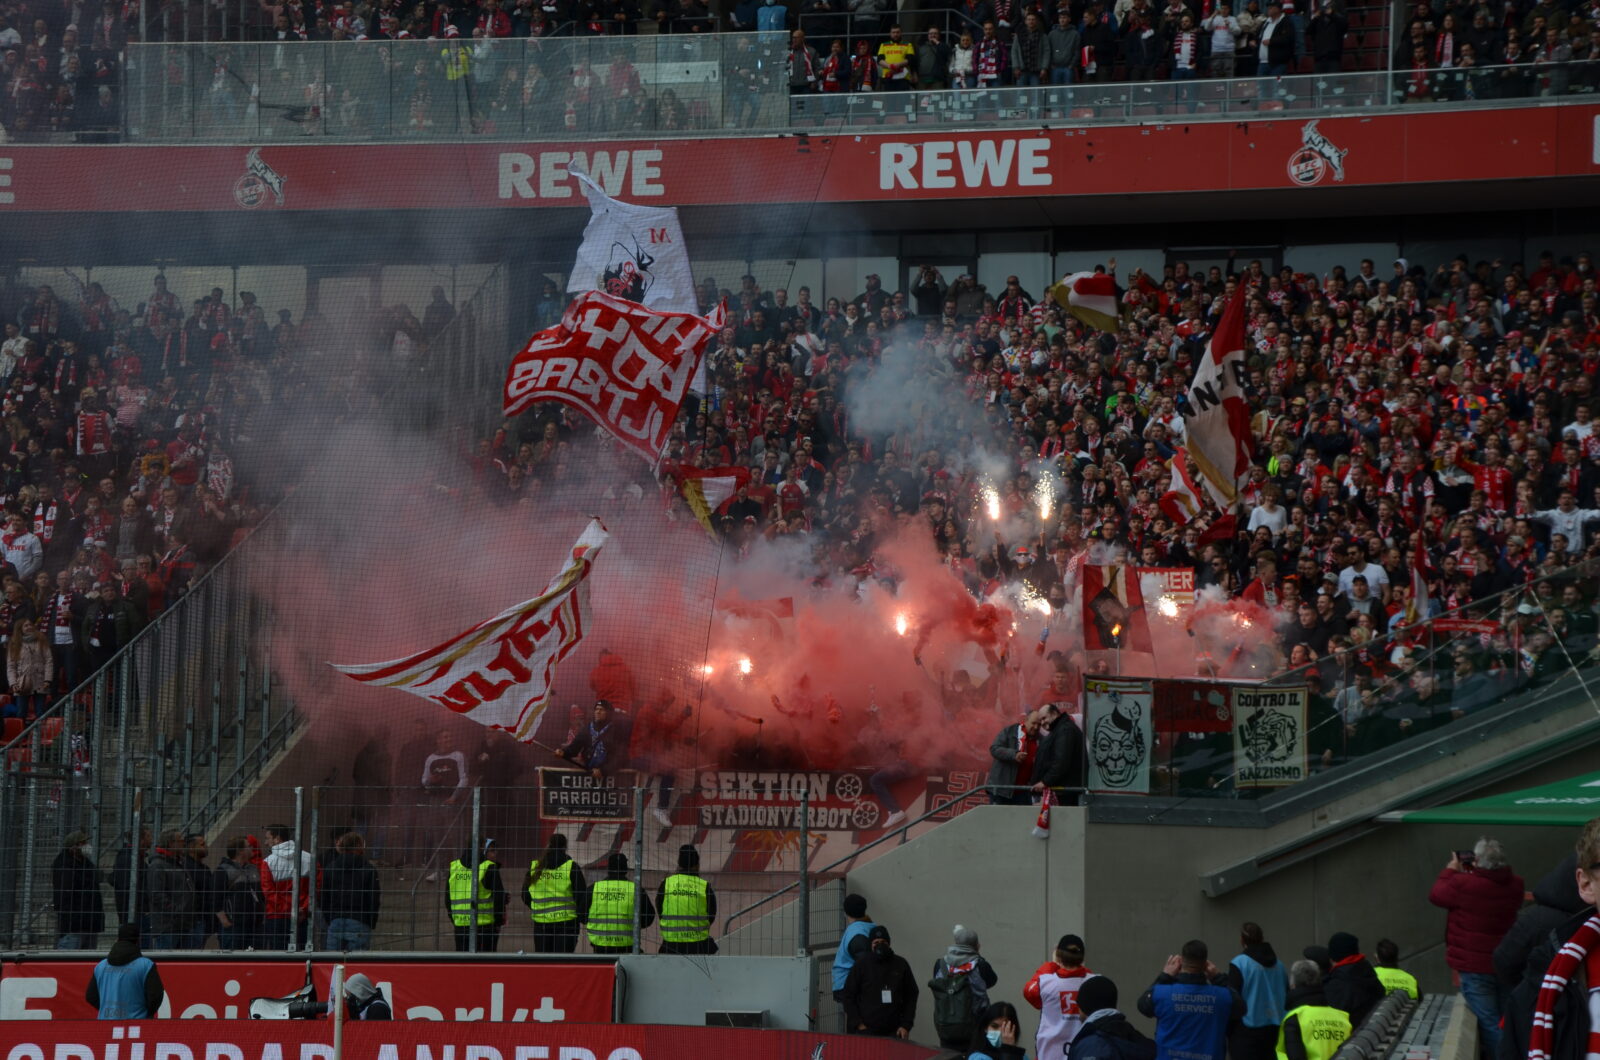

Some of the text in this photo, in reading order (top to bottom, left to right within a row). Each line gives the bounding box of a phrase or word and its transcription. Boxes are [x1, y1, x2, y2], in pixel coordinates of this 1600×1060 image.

[880, 138, 1053, 189] REWE
[498, 150, 665, 198] REWE
[1238, 692, 1300, 708] CONTRO IL
[1238, 766, 1301, 781] RAZZISMO
[700, 772, 830, 802] SEKTION
[702, 805, 852, 829] STADIONVERBOT
[1171, 993, 1217, 1004] SECURITY
[1174, 1003, 1215, 1015] SERVICE
[1313, 1030, 1345, 1041] ORDNER
